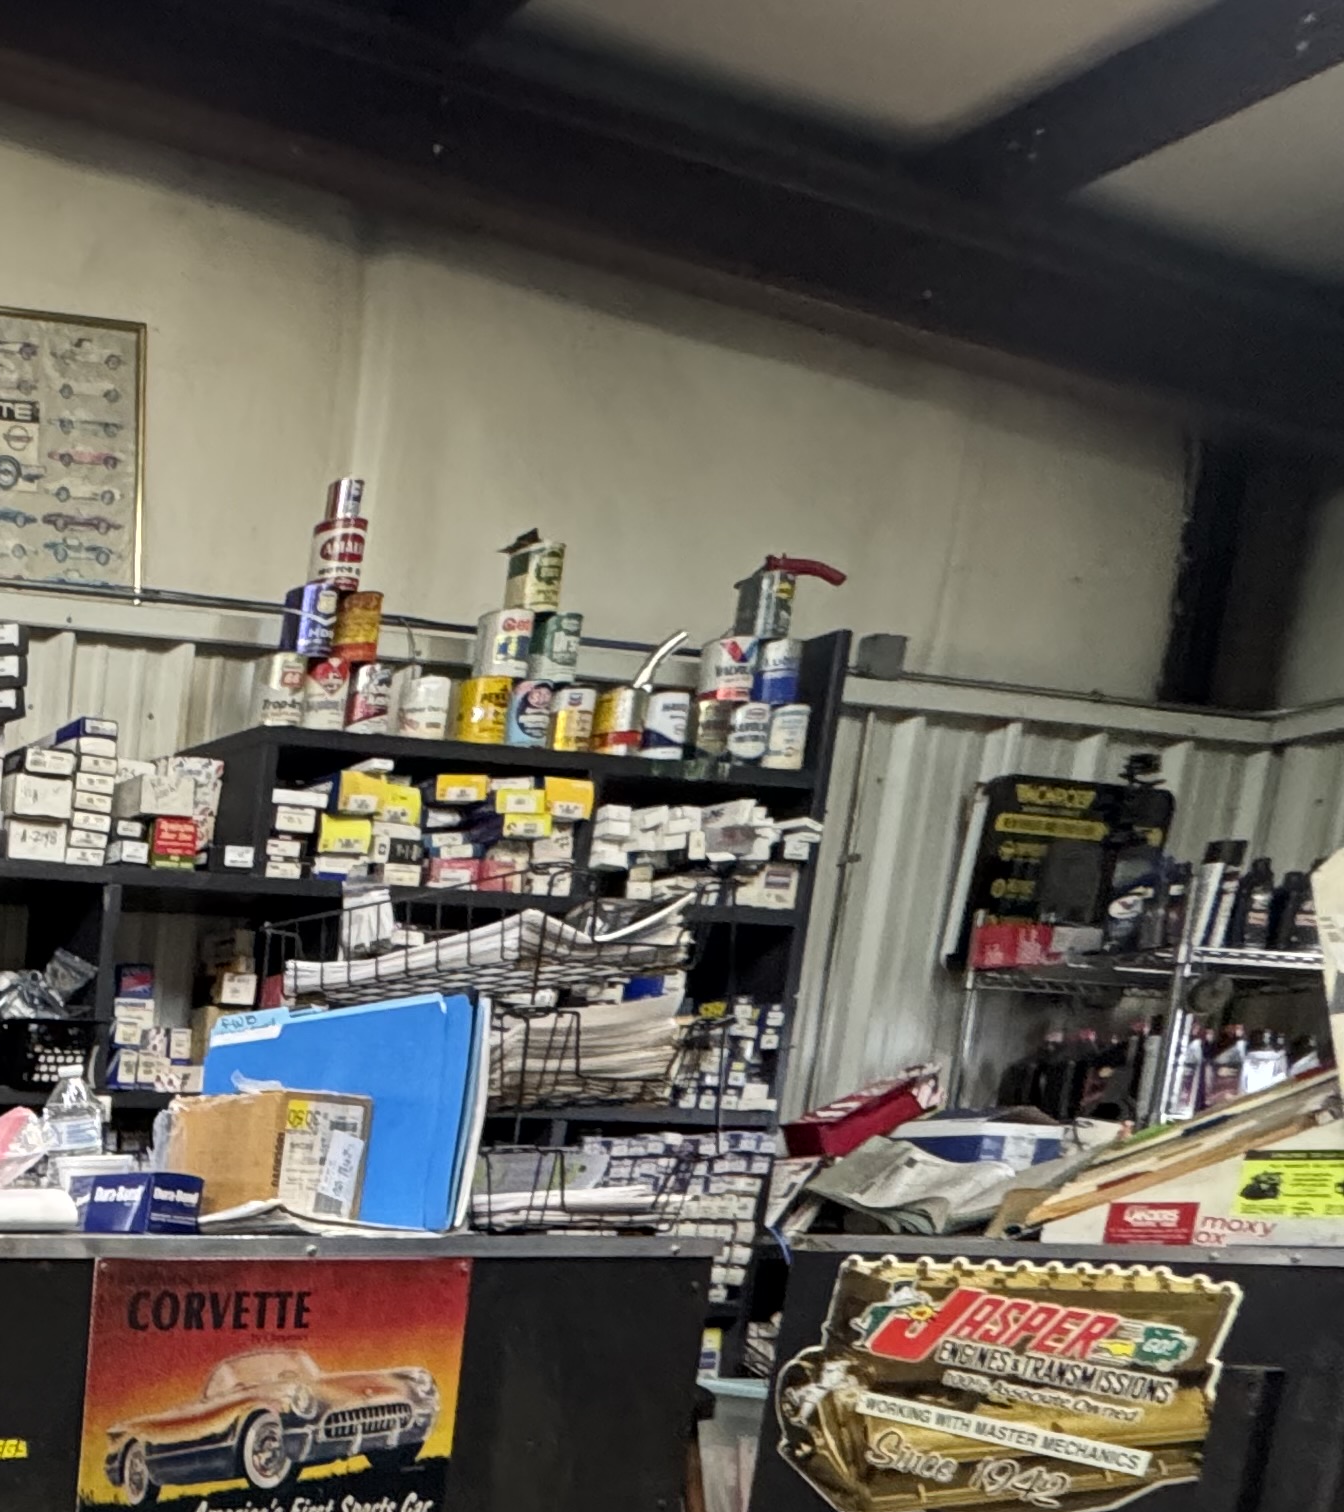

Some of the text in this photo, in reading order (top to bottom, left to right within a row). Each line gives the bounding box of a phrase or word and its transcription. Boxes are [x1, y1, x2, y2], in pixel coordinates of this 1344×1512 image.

[127, 1289, 313, 1333] CORVETTE
[868, 1287, 1120, 1363] JASPER
[936, 1340, 1013, 1373] ENGINES
[1021, 1354, 1173, 1403] TRANSMISSIONS
[866, 1398, 1141, 1470] WORKING WITH MASTER MECHANICS
[867, 1428, 1071, 1509] Since 1942
